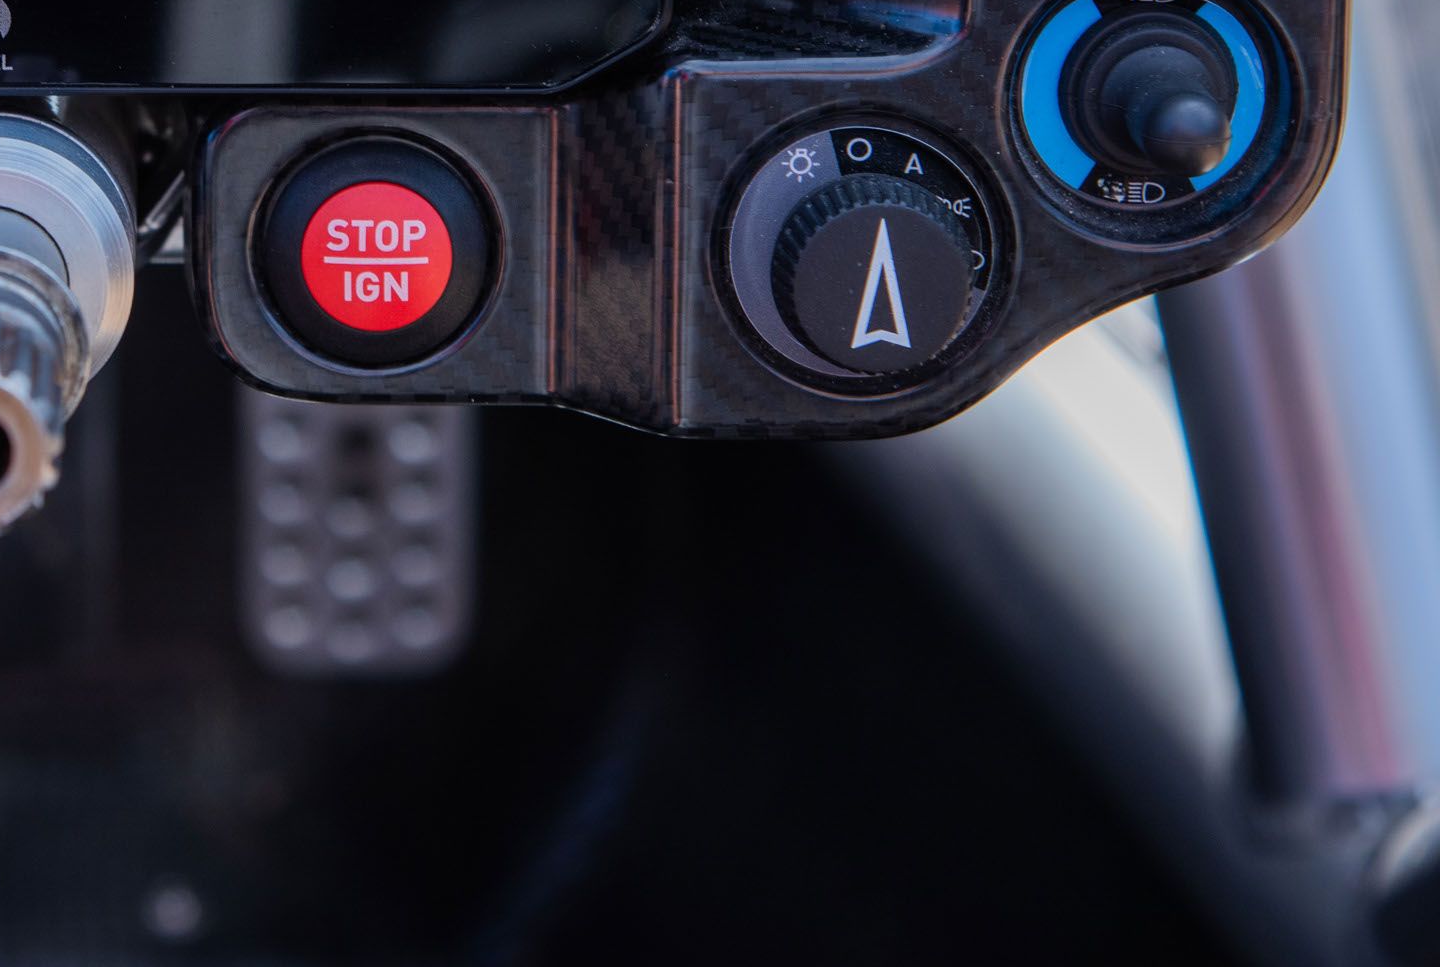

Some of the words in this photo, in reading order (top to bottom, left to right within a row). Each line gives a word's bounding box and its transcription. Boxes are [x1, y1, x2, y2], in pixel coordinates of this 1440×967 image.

[903, 152, 924, 175] A
[326, 218, 427, 252] STOP
[343, 270, 409, 303] IGN
